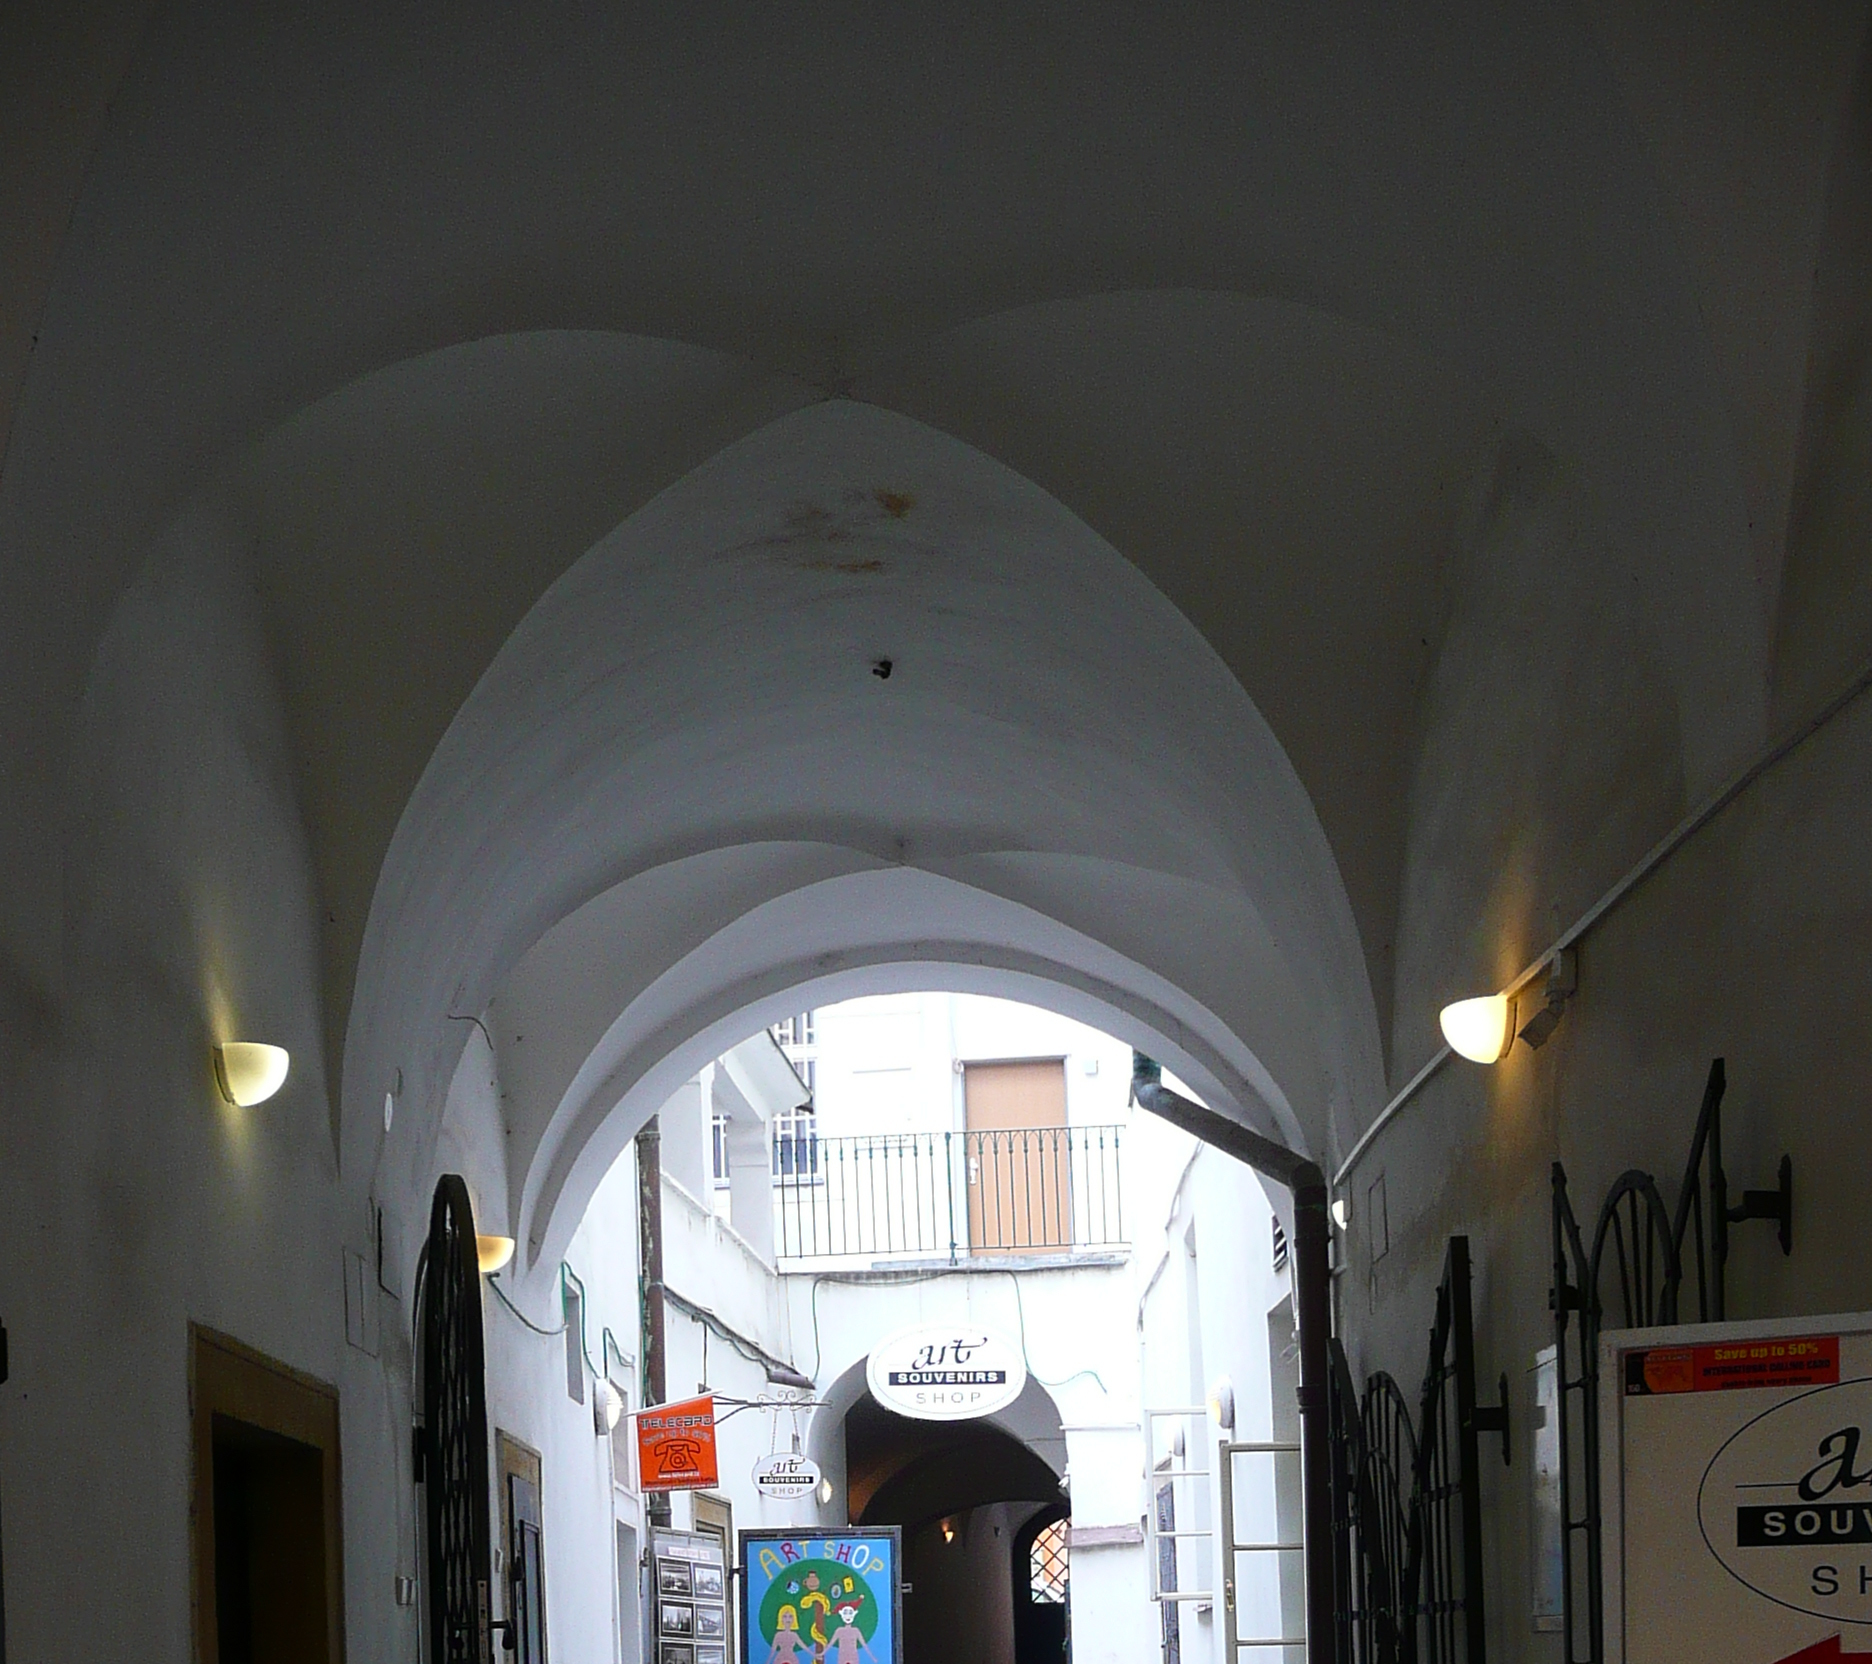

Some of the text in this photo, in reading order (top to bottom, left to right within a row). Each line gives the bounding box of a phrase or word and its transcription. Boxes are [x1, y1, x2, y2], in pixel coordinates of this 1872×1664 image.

[911, 1337, 988, 1370] art
[1714, 1342, 1819, 1361] Save up to 50%
[897, 1372, 999, 1384] SOUVENIRS
[916, 1391, 981, 1405] SHOP
[639, 1414, 713, 1429] TELECARD
[769, 1457, 806, 1476] art
[1799, 1427, 1872, 1500] a
[771, 1487, 803, 1495] SHOP
[759, 1540, 885, 1580] ART SHOP
